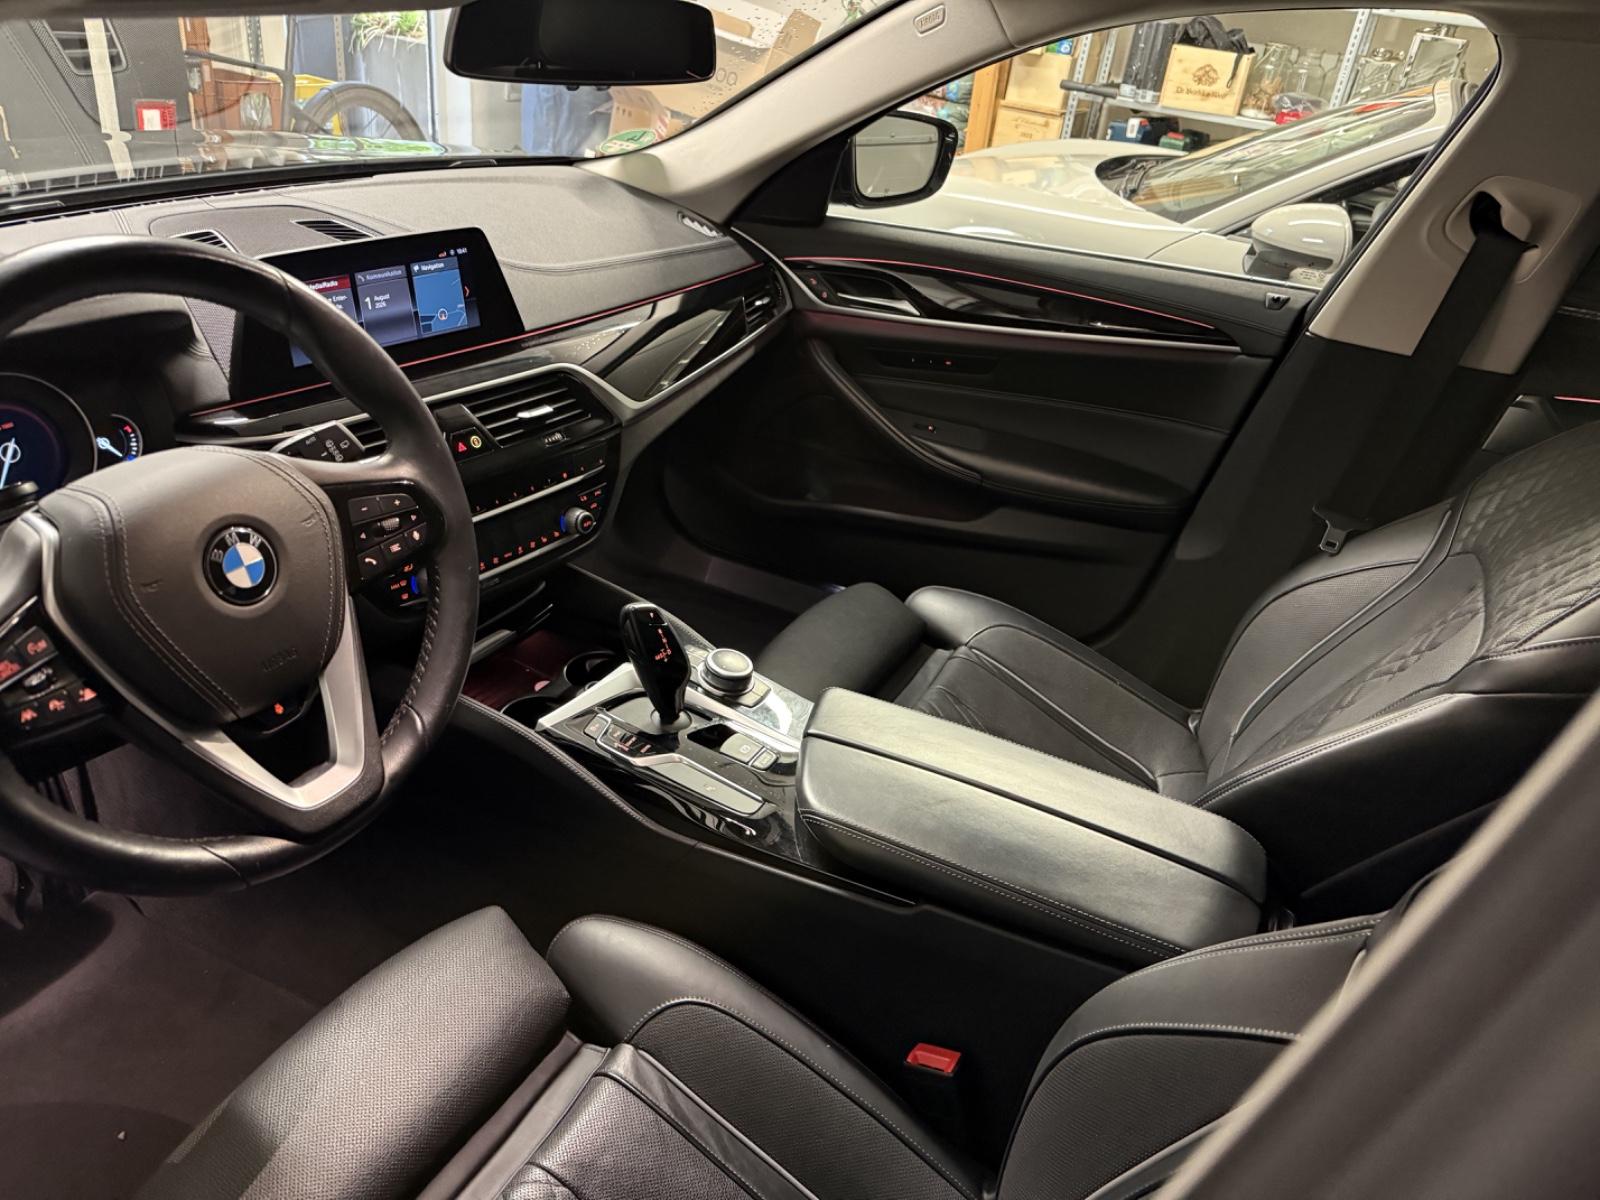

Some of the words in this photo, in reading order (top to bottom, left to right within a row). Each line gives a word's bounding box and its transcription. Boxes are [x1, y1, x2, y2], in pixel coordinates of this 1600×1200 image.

[420, 262, 445, 271] Navigation
[366, 270, 402, 280] Kommunikation
[374, 293, 390, 302] August
[364, 296, 372, 310] 1
[210, 531, 262, 562] BMW
